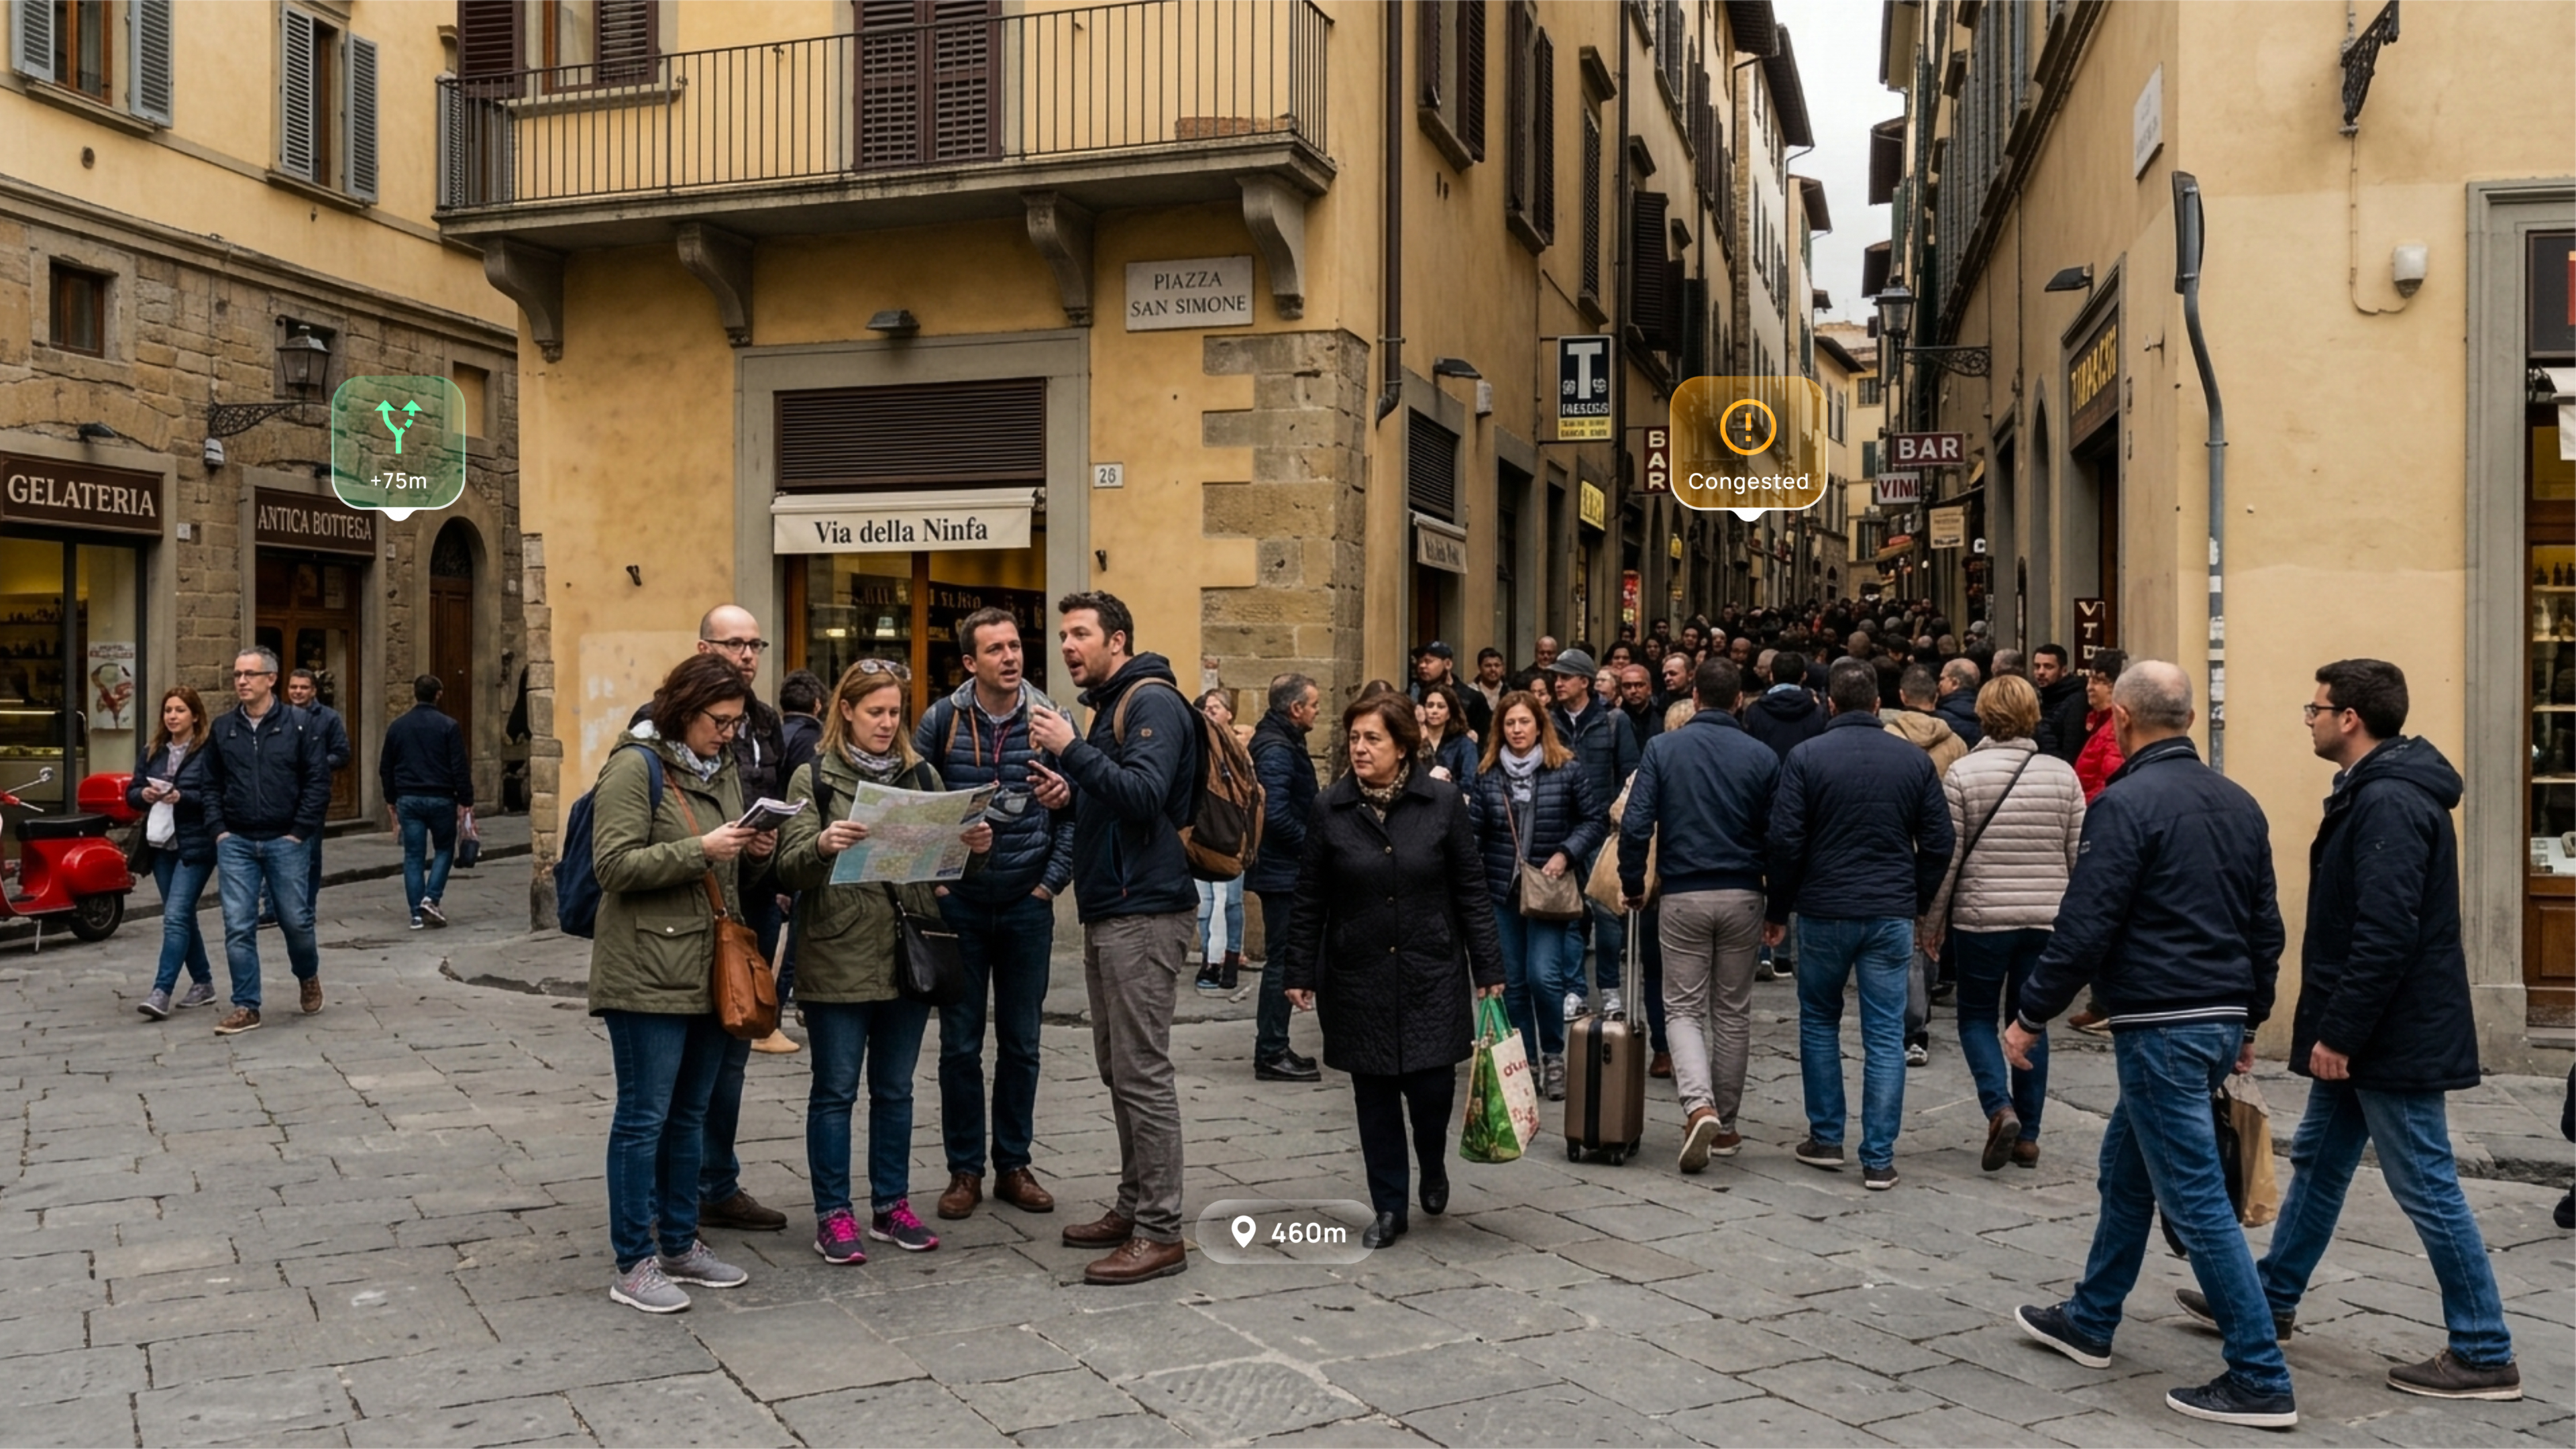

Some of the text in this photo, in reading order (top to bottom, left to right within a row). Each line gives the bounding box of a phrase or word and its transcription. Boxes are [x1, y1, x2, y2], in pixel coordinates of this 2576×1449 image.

[1154, 271, 1223, 290] PIAZZA
[1130, 295, 1246, 317] SAN SIMONE
[1567, 342, 1602, 398] T
[1648, 430, 1666, 489] BAR
[1898, 437, 1958, 460] BAR
[7, 474, 156, 517] GELATERIA
[258, 504, 309, 535] ANTICA
[814, 517, 988, 545] Via della Ninfa
